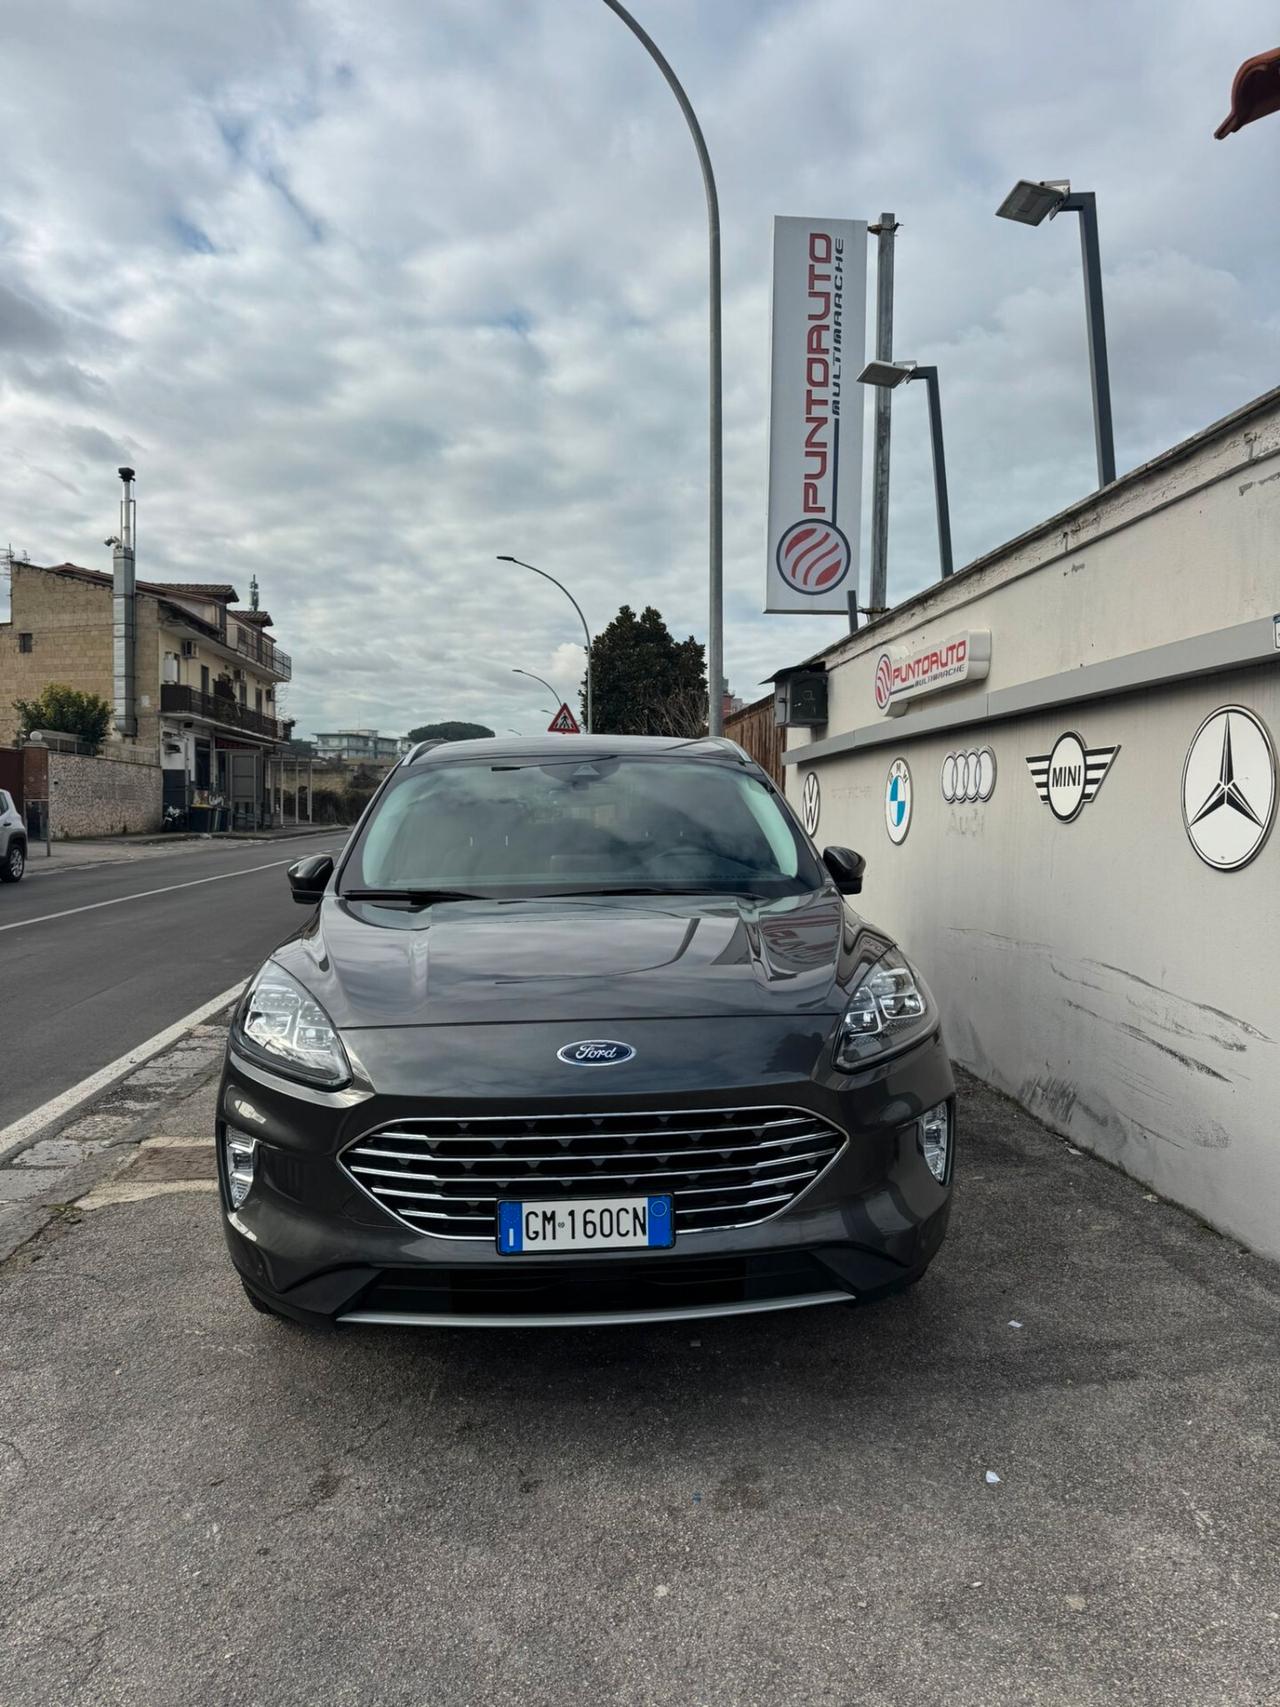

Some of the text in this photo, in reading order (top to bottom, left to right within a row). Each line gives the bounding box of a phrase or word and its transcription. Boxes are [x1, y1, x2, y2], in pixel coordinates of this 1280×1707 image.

[831, 237, 845, 416] MULTIMARCHE
[803, 232, 832, 513] PUNTOAUTO
[892, 639, 967, 686] PUNTOAUTO
[1051, 765, 1081, 788] MINI
[575, 1043, 617, 1059] Ford
